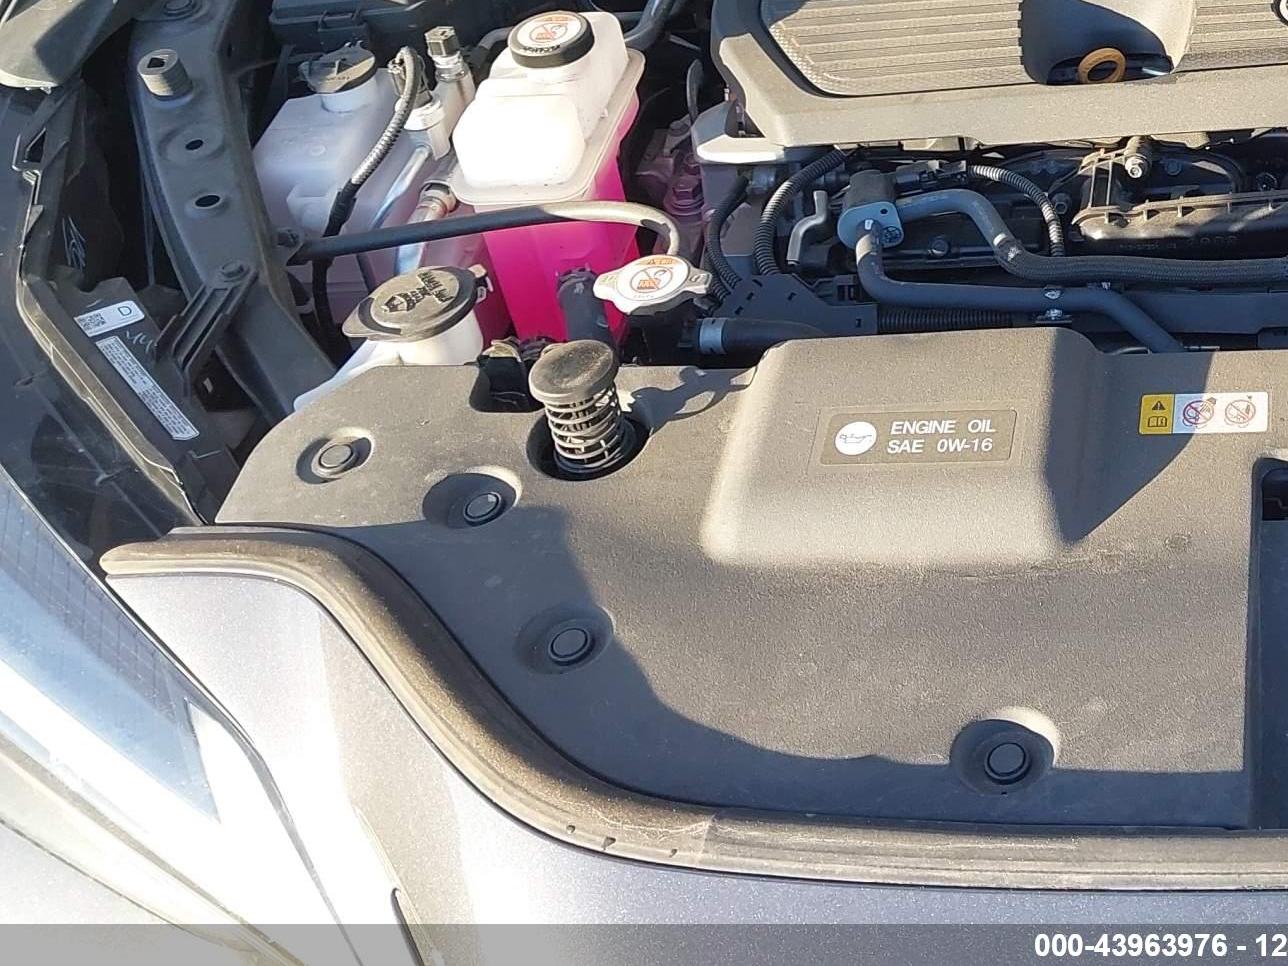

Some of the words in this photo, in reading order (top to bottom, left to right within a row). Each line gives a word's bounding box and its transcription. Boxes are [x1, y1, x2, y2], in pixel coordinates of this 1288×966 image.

[890, 419, 956, 435] ENGINE
[967, 418, 996, 434] OIL
[886, 439, 925, 454] SAE
[936, 438, 993, 453] 0W-16
